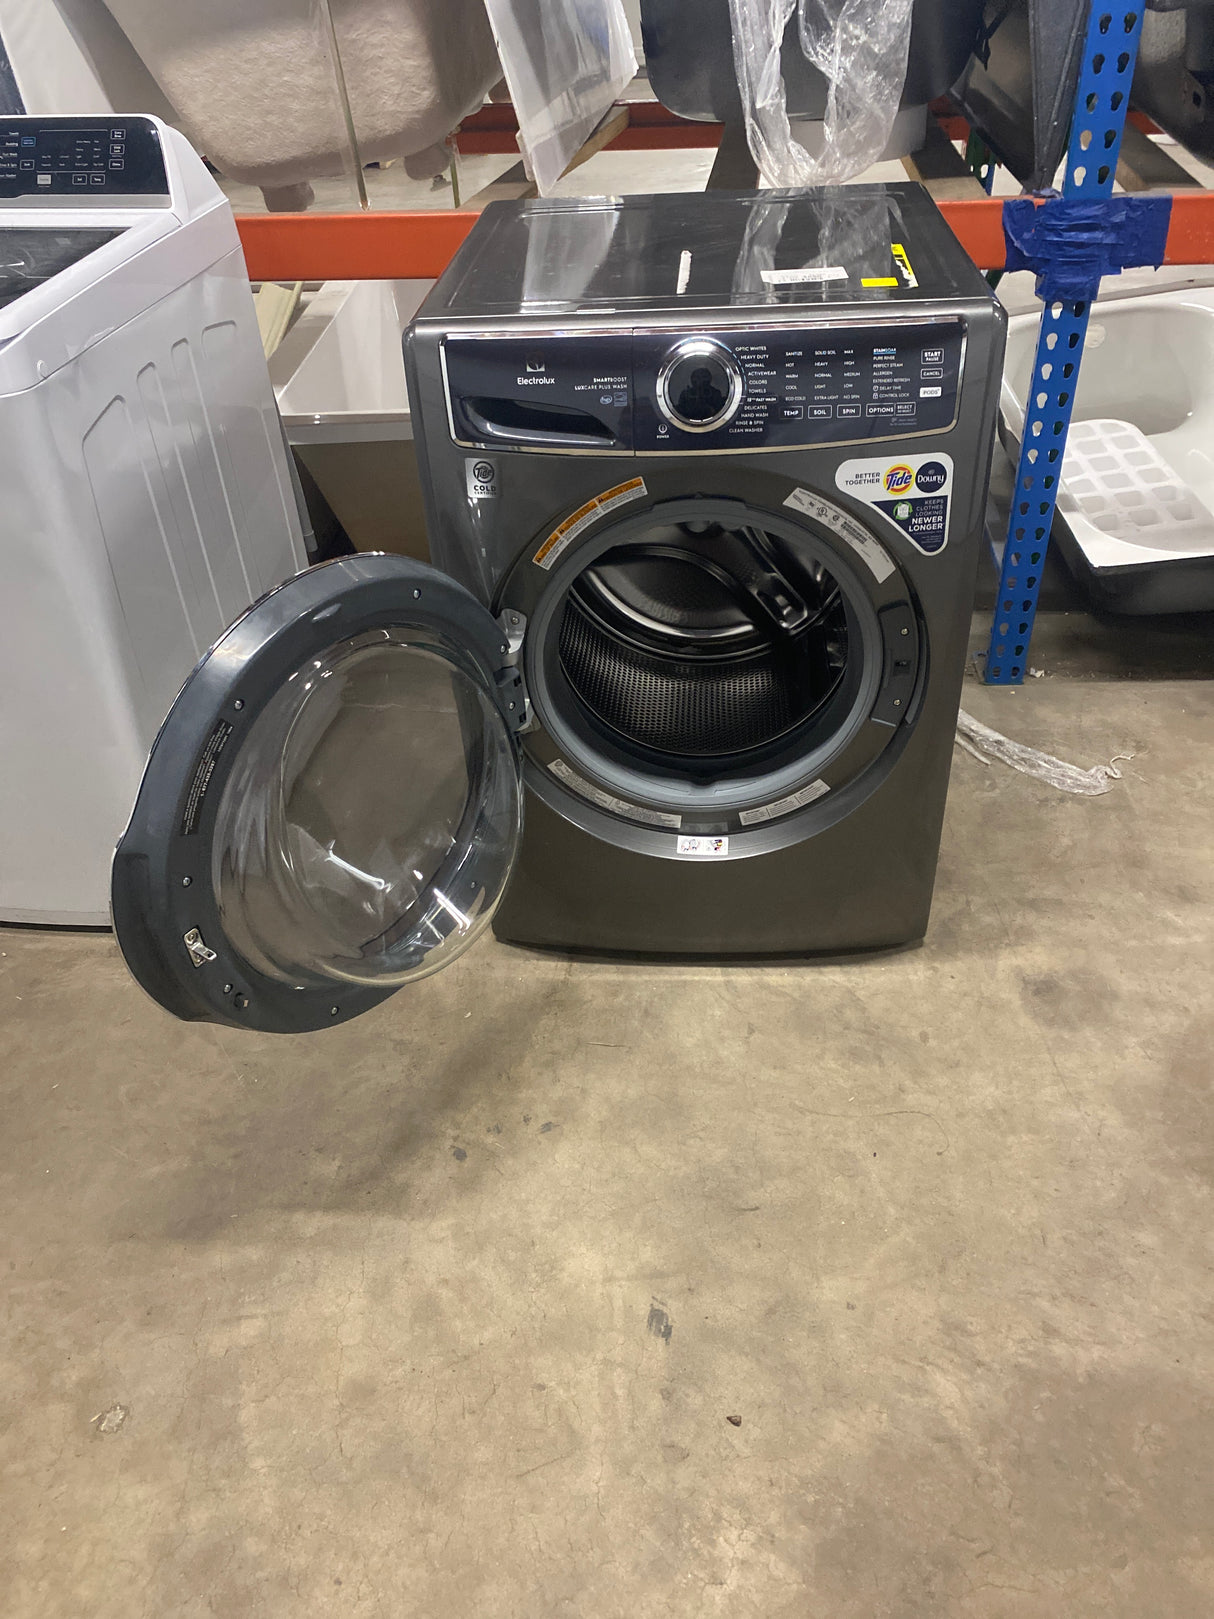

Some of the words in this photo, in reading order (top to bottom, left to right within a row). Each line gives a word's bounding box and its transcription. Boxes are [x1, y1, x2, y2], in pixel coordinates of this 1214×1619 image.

[517, 377, 555, 385] Electrolux
[887, 471, 912, 491] Tide
[917, 474, 944, 484] Downy
[912, 516, 943, 525] NEWER
[908, 523, 943, 532] LONGER
